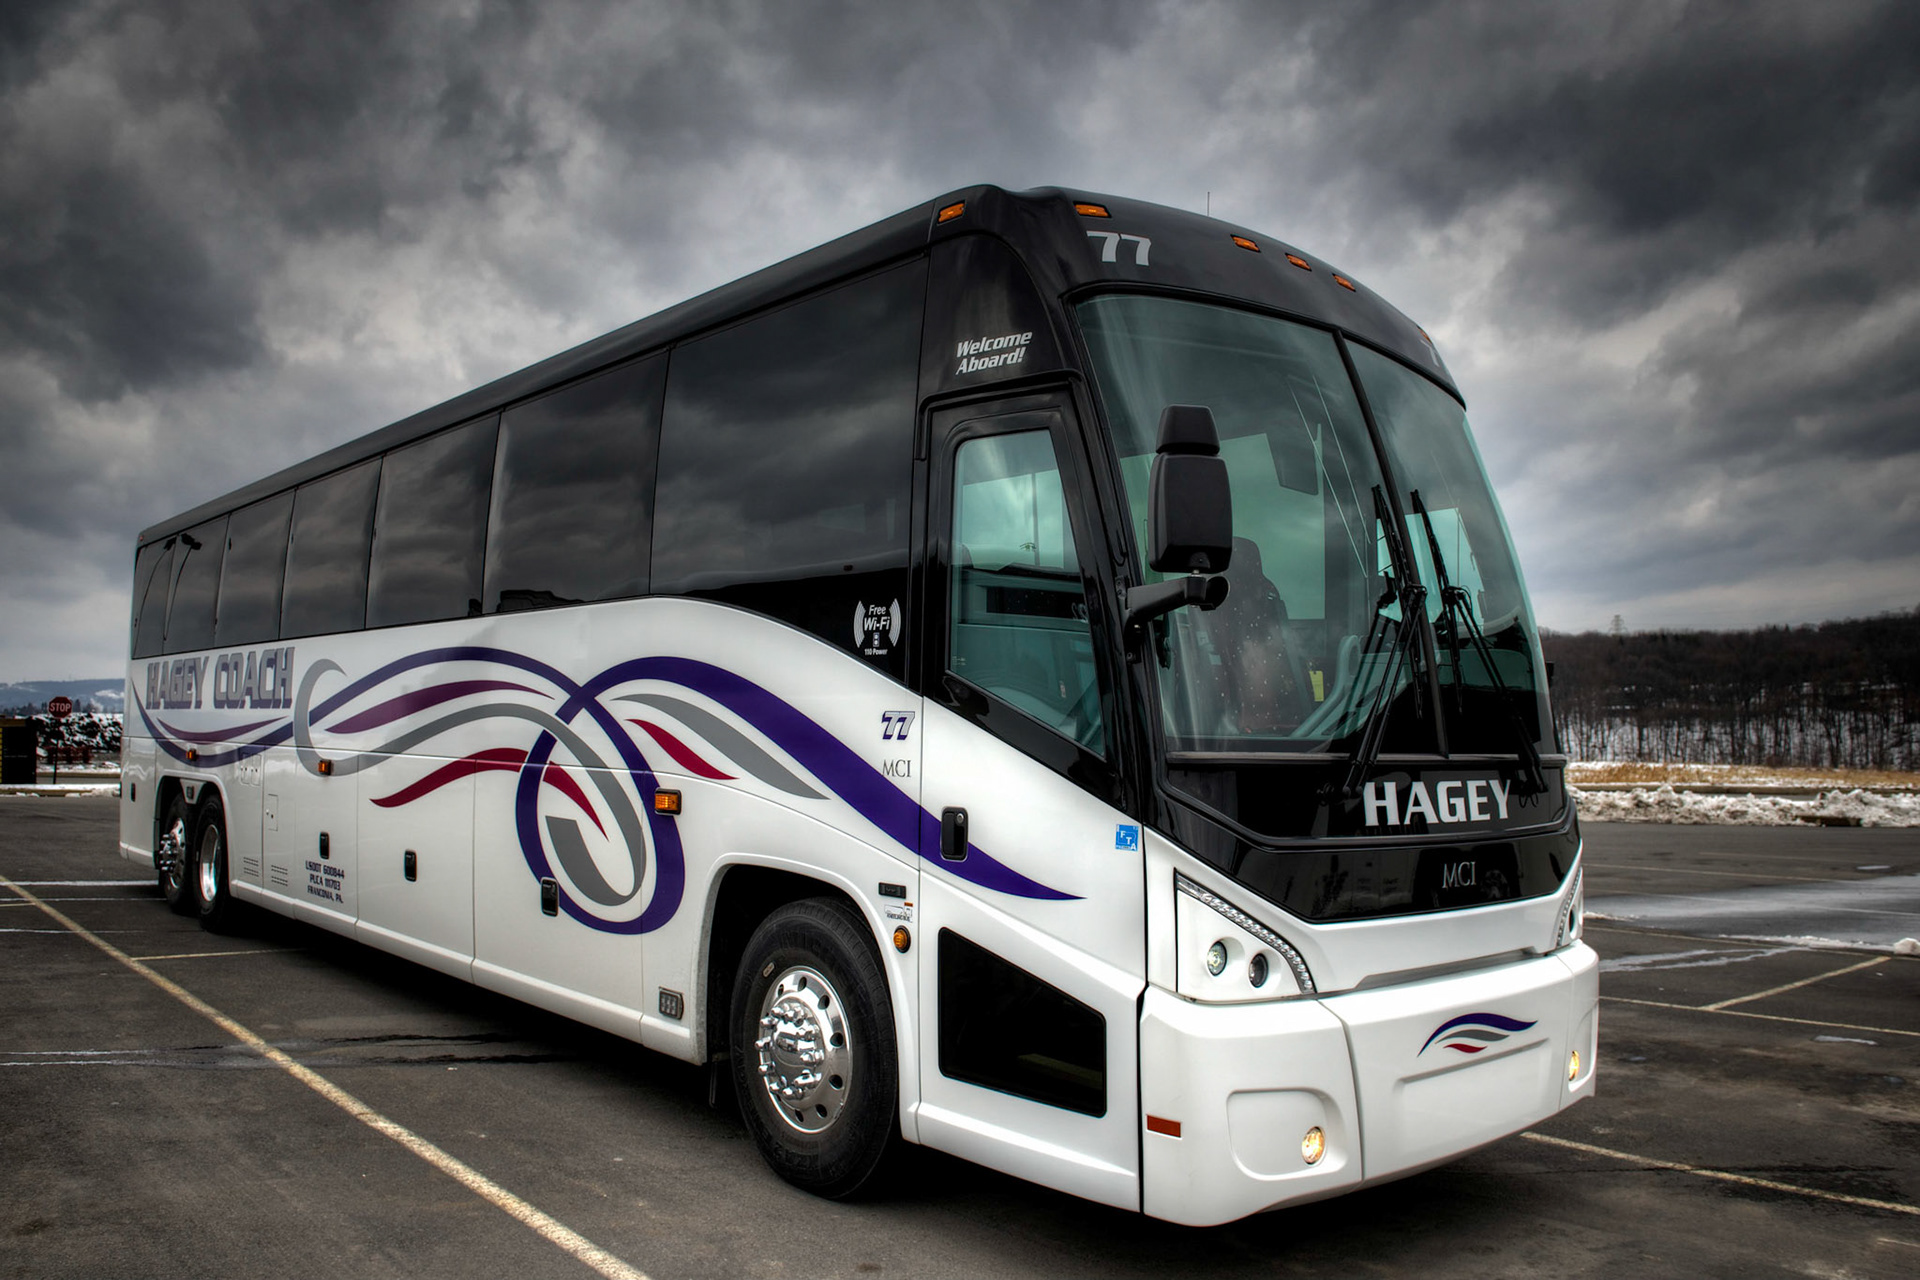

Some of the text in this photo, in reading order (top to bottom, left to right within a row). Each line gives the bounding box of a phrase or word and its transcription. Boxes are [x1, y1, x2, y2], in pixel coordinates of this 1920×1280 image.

[1086, 230, 1151, 266] 77
[956, 332, 1033, 357] Welcome
[955, 347, 1026, 375] Aboard!
[868, 604, 887, 615] Free
[864, 616, 890, 631] Wi-Fi
[146, 647, 295, 709] HAGEY COACH
[50, 702, 71, 712] STOP
[881, 711, 915, 740] 77
[882, 759, 911, 777] MCI
[1363, 779, 1511, 826] HAGEY
[1442, 861, 1476, 888] MCI
